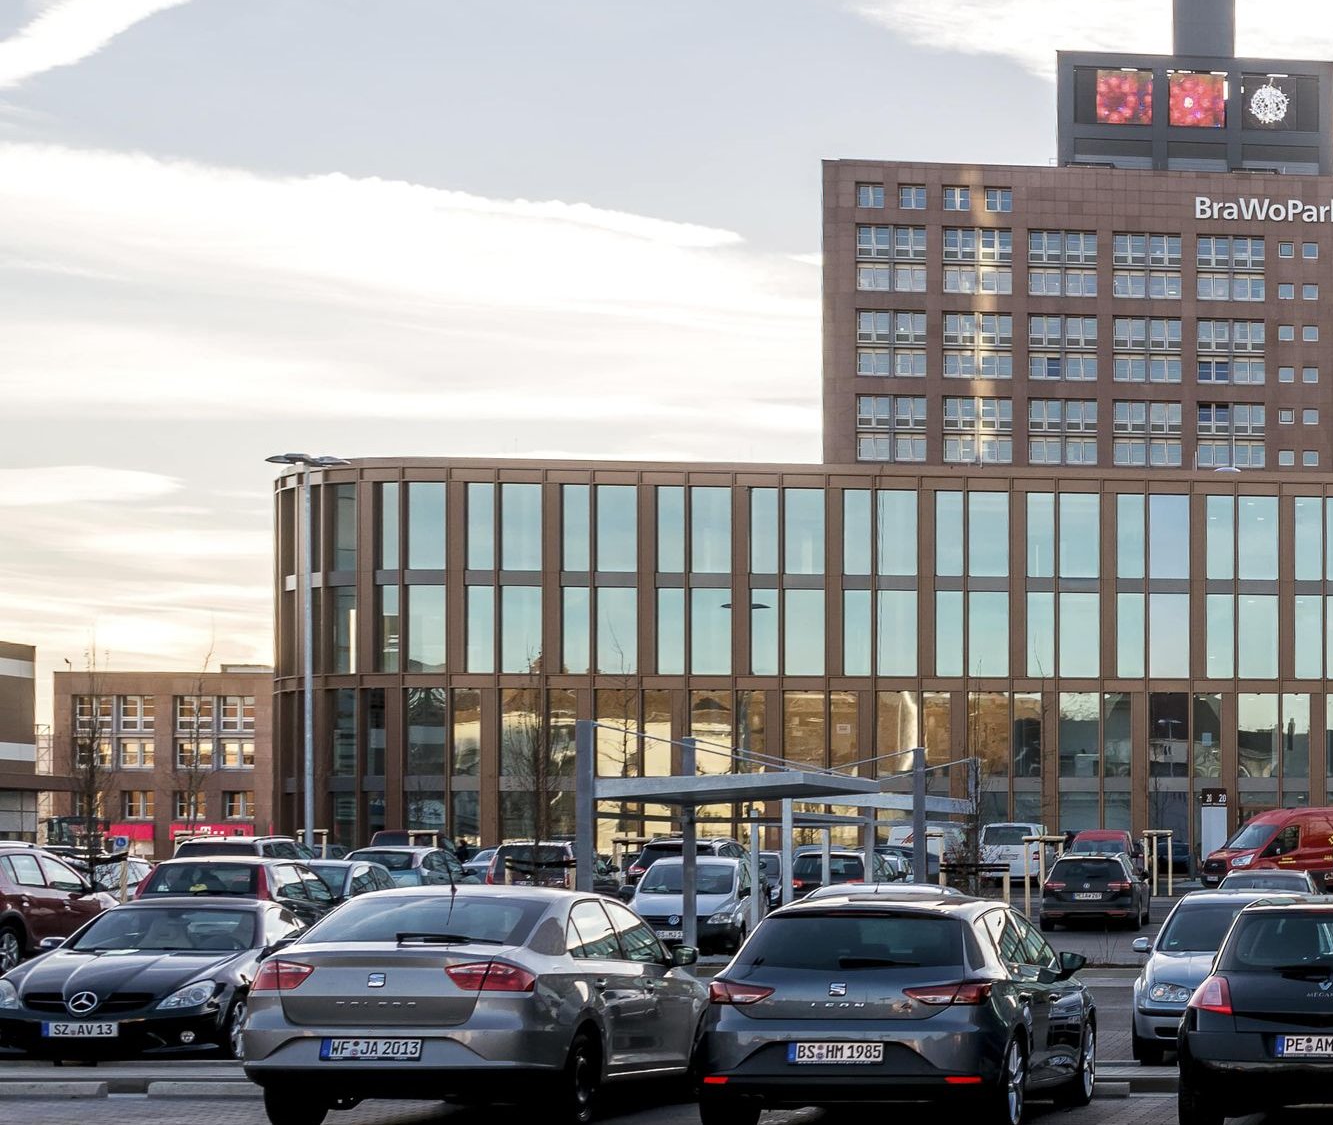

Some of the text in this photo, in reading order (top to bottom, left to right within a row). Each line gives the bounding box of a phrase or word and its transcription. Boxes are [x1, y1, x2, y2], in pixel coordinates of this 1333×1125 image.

[1218, 793, 1227, 803] 20
[53, 1024, 113, 1035] SZ AV 13
[331, 1040, 419, 1056] WF JA 2013
[797, 1044, 882, 1059] BS HM 1985
[1285, 1038, 1304, 1052] PE
